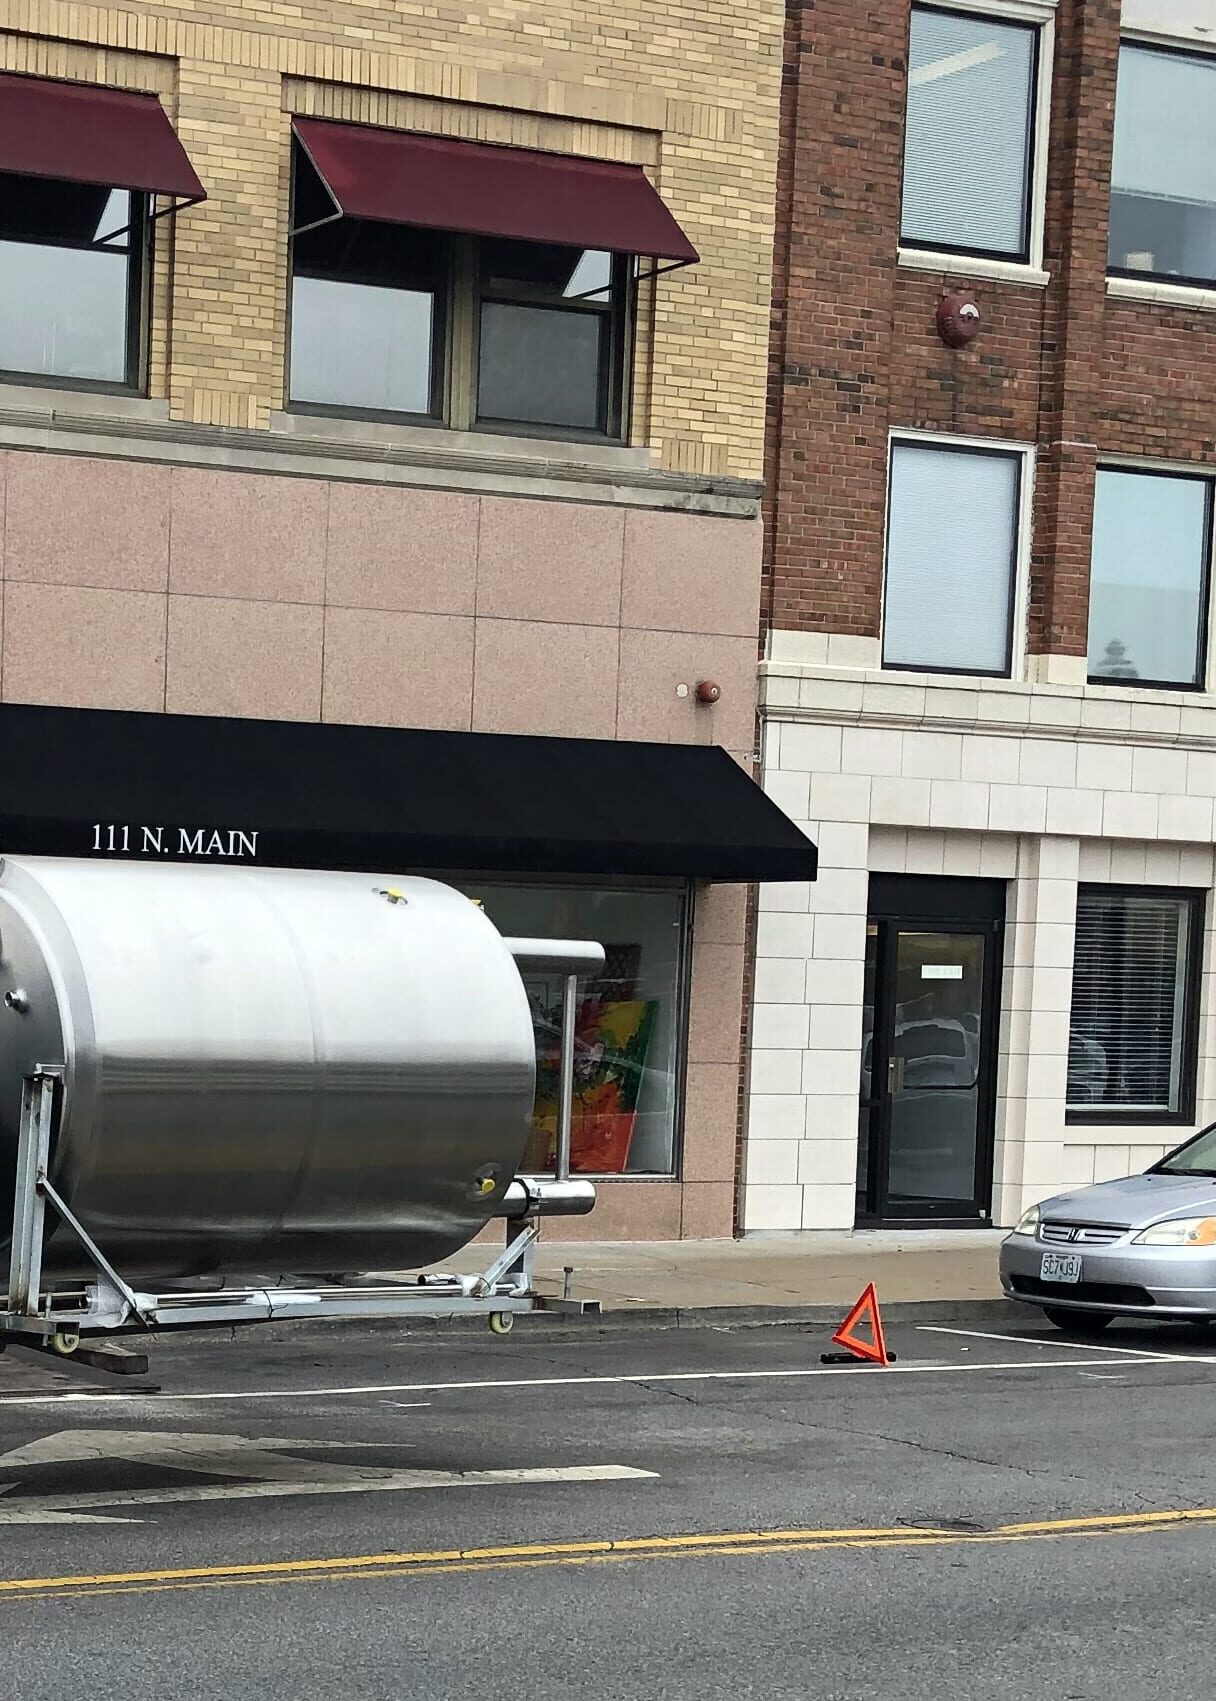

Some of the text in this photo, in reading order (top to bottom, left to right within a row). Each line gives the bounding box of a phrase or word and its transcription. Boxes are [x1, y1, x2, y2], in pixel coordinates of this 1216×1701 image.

[92, 823, 259, 857] 111 N. MAIN
